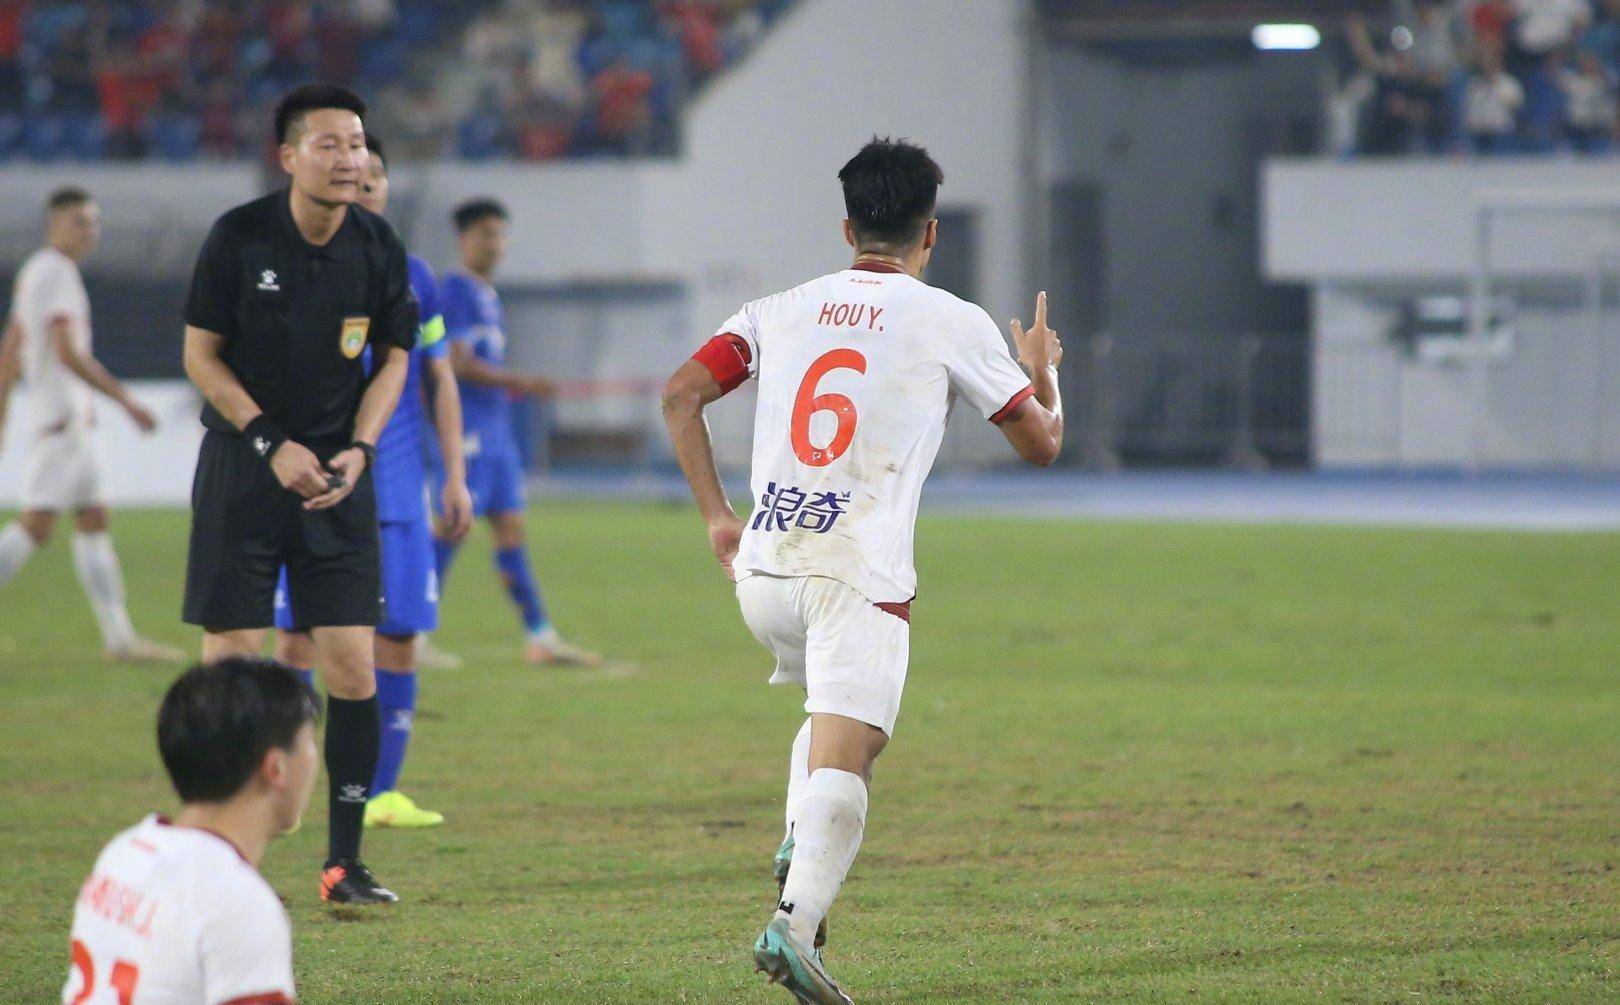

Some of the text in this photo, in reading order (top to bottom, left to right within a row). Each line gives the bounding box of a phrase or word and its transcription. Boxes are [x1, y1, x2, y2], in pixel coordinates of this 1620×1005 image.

[818, 302, 865, 327] HOU
[790, 348, 867, 468] 6
[751, 481, 851, 534] 浪奇
